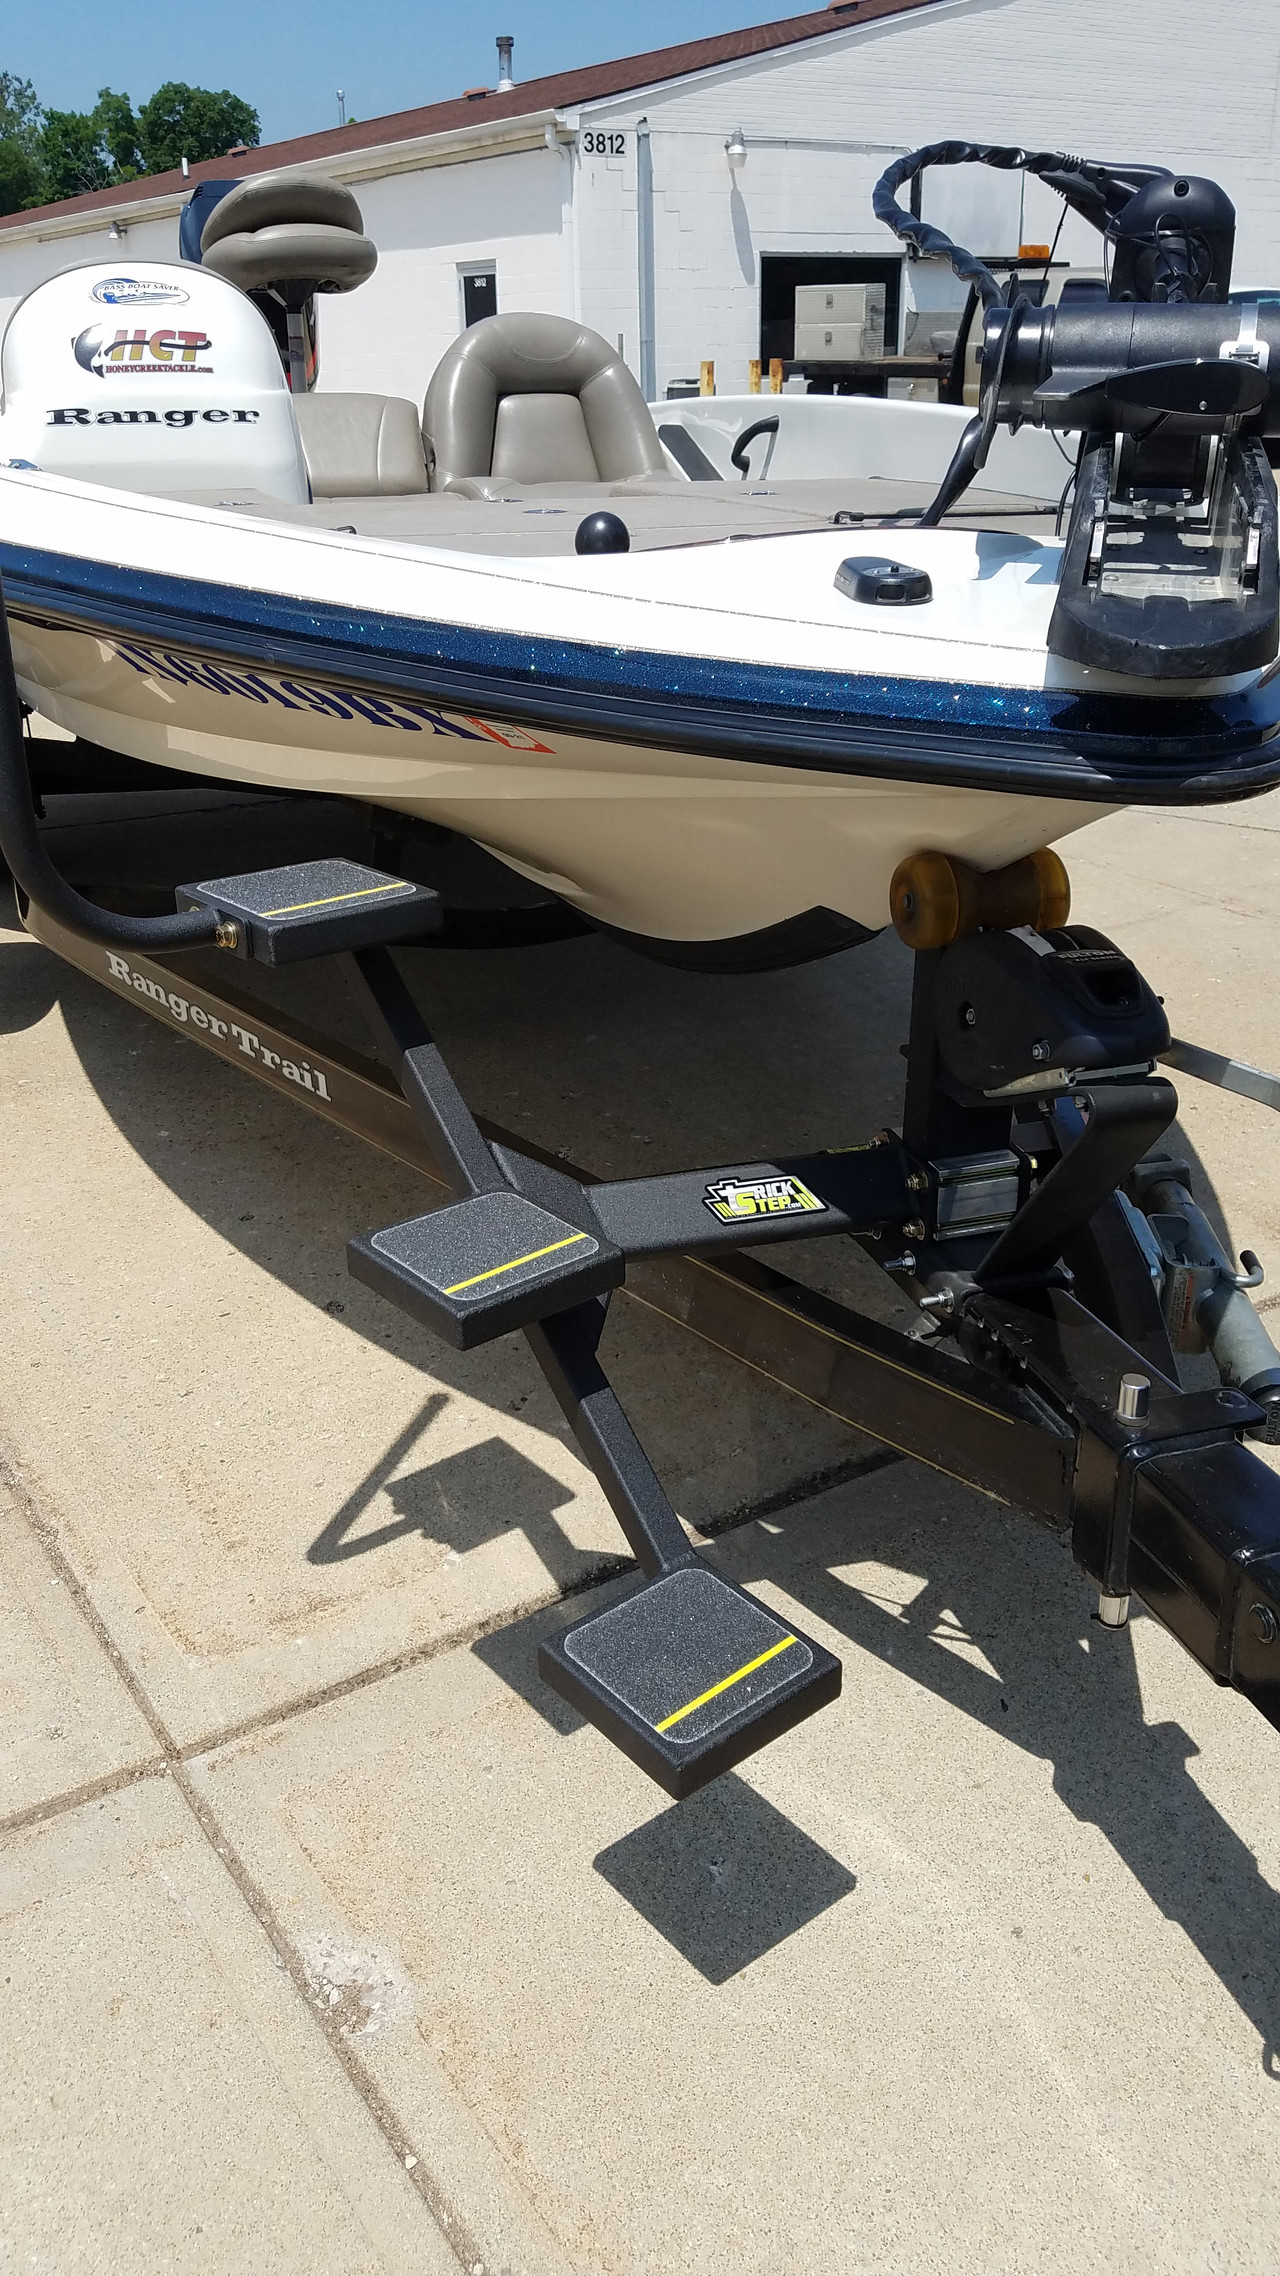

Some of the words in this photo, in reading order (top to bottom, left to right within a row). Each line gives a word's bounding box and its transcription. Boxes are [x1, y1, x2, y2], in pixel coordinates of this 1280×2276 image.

[584, 132, 625, 154] 3812
[46, 408, 260, 428] Ranger
[105, 950, 229, 1042] Ranger
[231, 1022, 332, 1102] Trail
